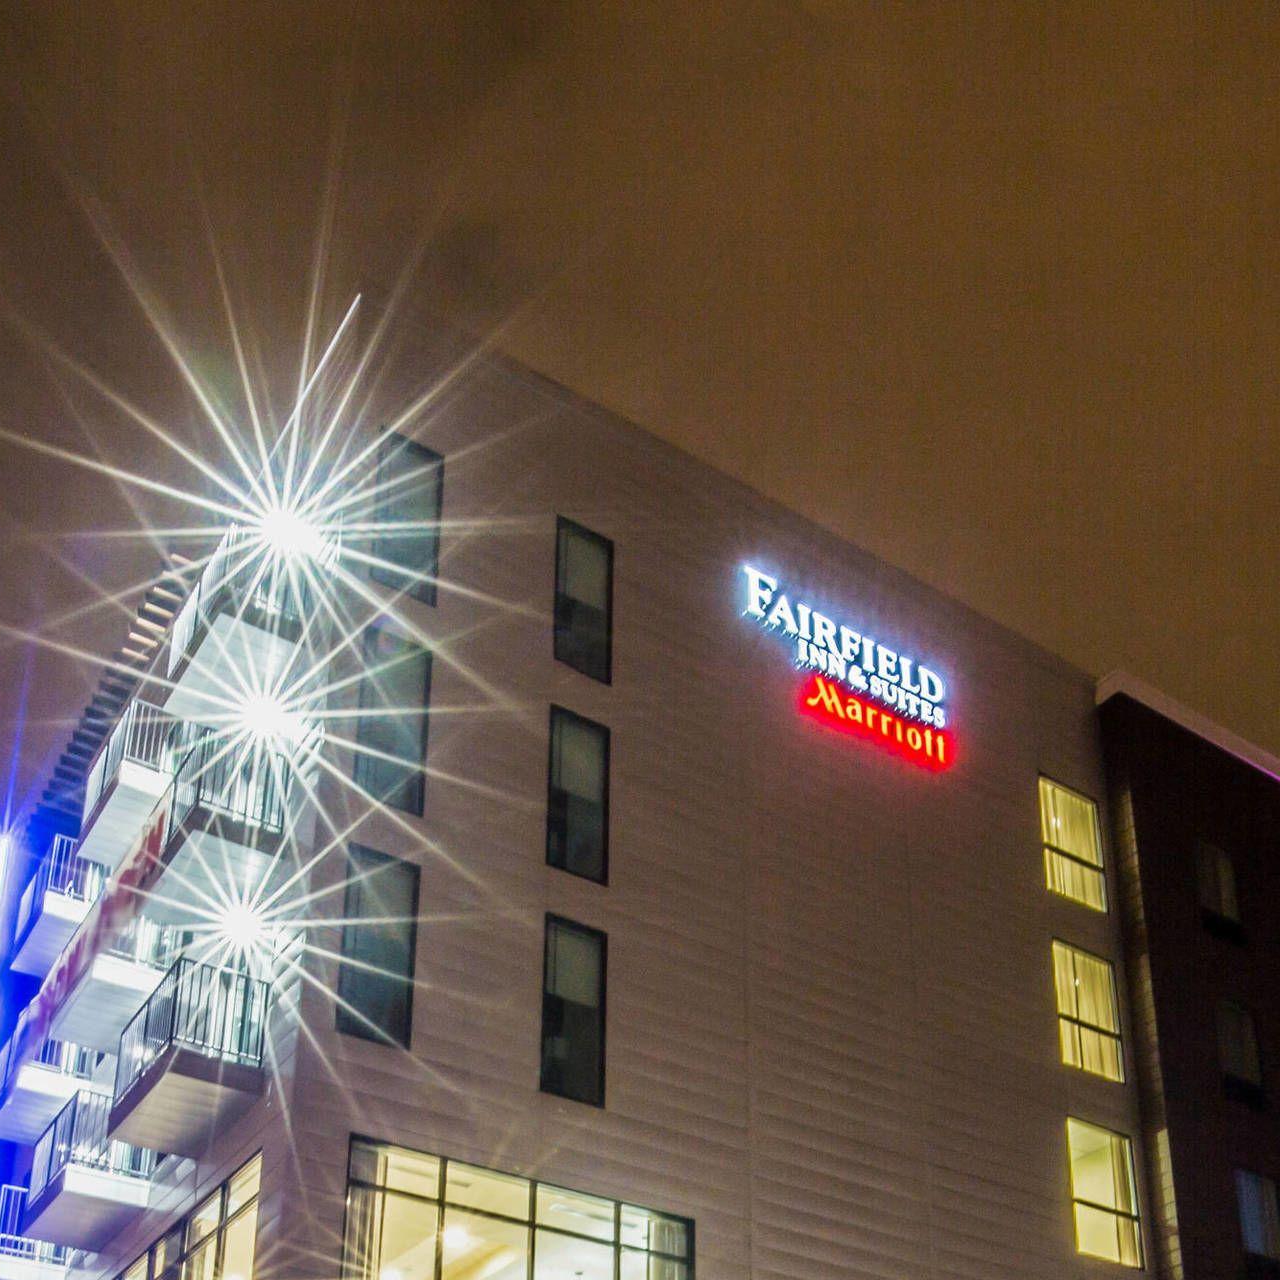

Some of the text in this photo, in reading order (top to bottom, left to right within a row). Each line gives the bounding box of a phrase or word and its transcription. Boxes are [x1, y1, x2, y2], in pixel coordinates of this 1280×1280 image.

[742, 564, 945, 705] FAIRFIELD
[795, 638, 947, 729] INN & SUITES
[805, 675, 947, 764] Marriott
